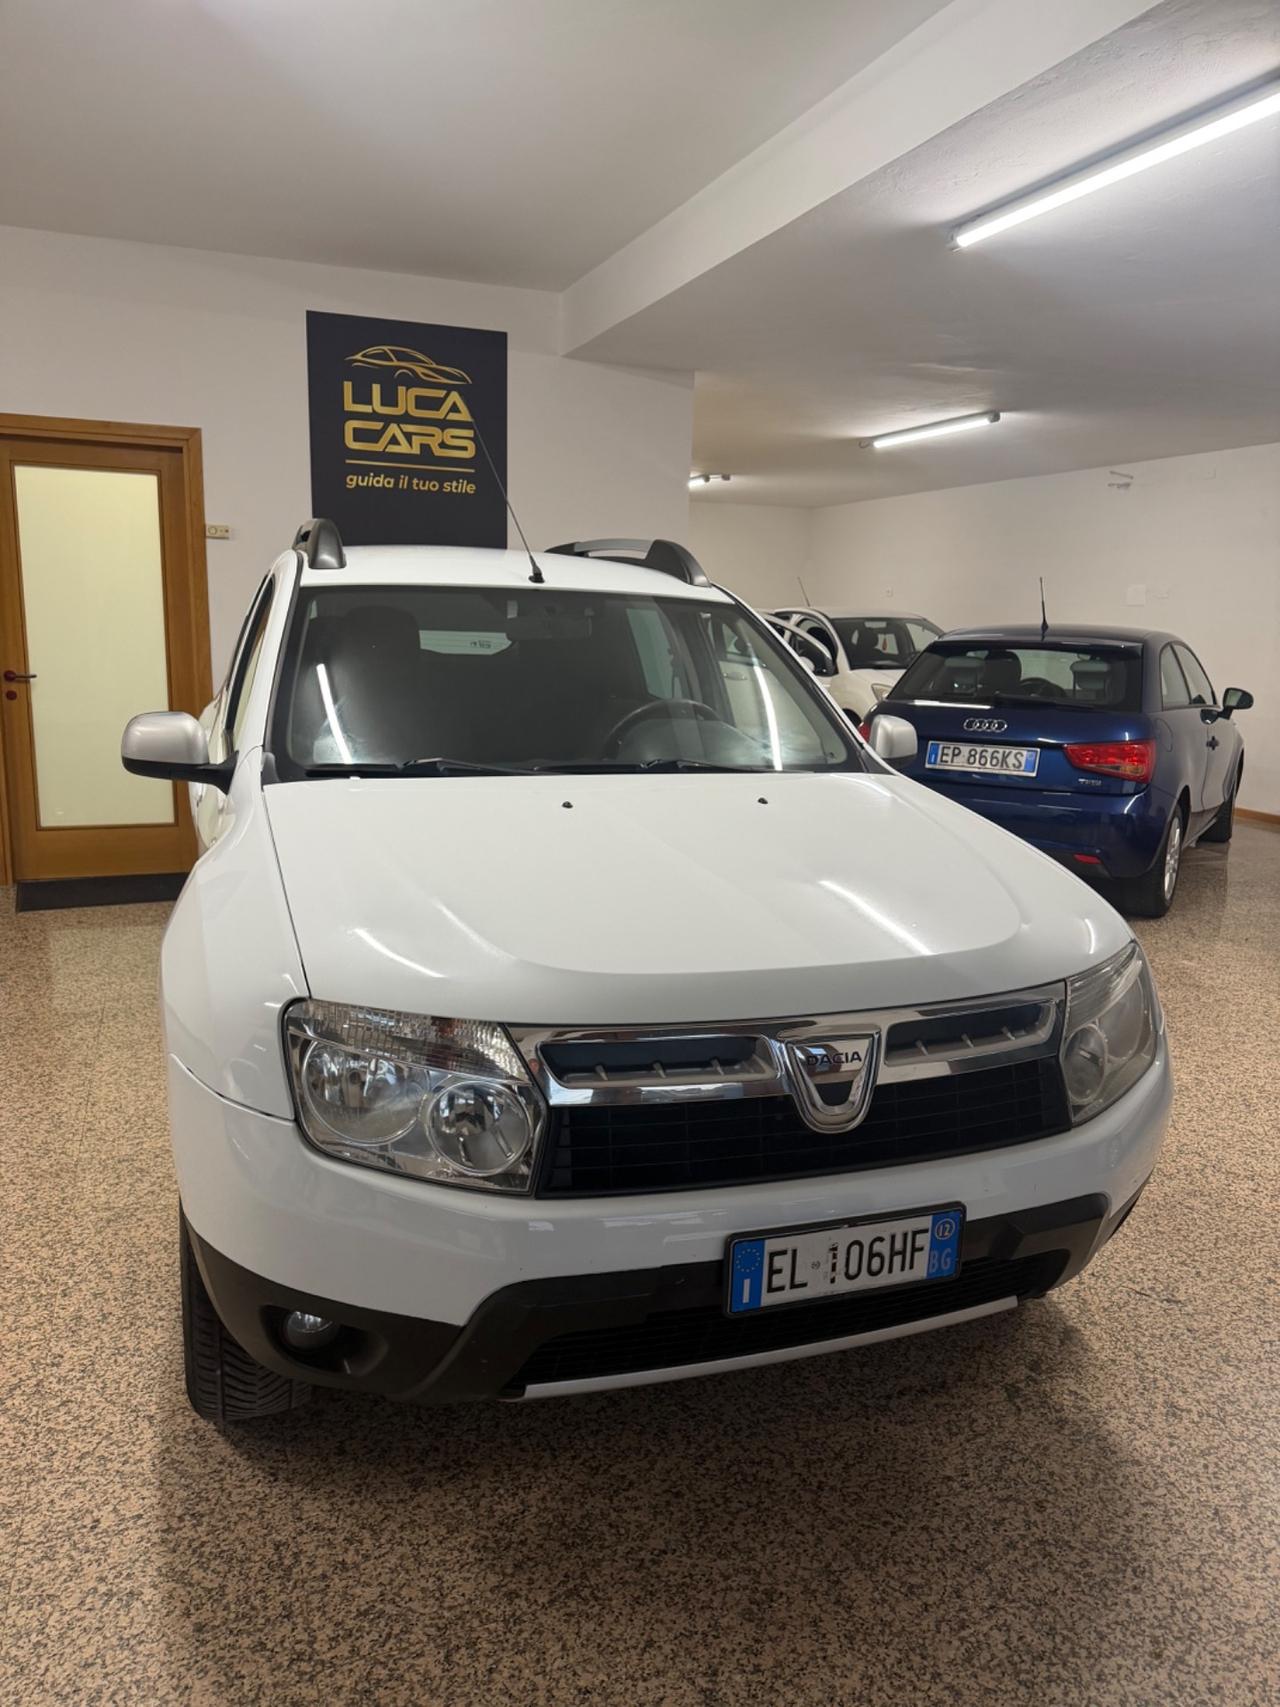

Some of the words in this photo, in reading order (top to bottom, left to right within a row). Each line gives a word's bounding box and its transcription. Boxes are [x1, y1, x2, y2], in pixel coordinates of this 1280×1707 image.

[343, 380, 474, 422] LUCA
[344, 420, 476, 459] CARS
[346, 473, 394, 489] guida
[398, 475, 408, 489] il
[412, 478, 440, 491] tuo
[442, 479, 476, 494] stile
[939, 746, 962, 764] EP
[967, 748, 1024, 770] 866KS
[806, 1050, 862, 1066] DACIA
[766, 1248, 808, 1294] EL
[928, 1247, 952, 1273] BG
